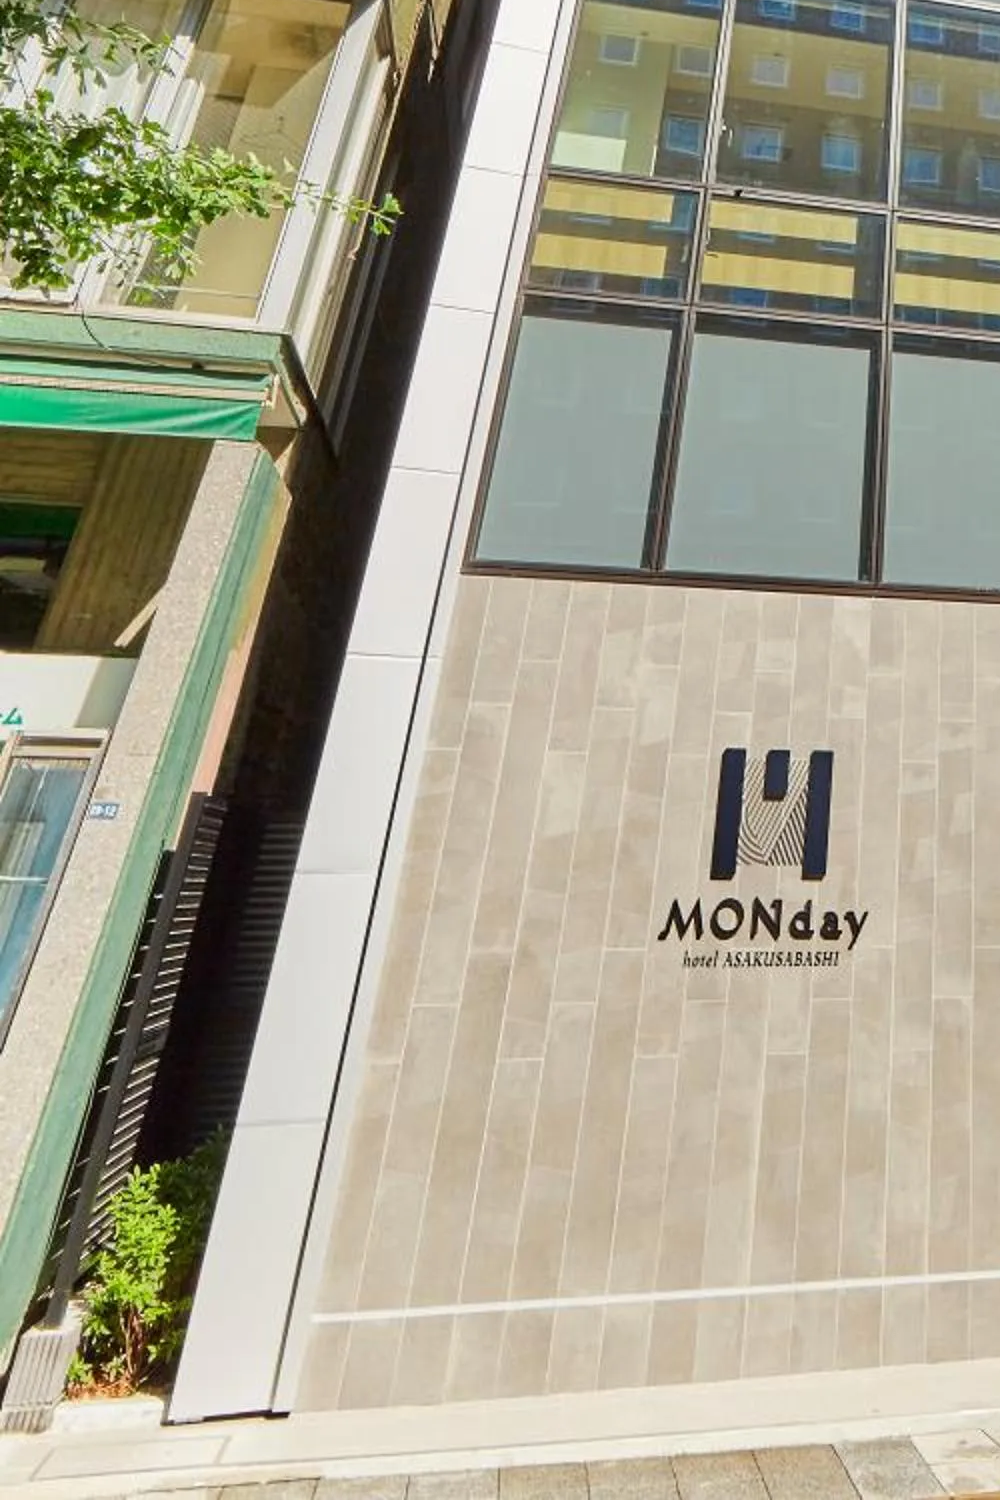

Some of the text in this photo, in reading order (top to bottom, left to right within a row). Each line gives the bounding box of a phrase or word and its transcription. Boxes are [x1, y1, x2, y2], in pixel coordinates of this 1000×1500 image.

[0, 707, 23, 724] ム
[657, 896, 868, 951] MONday
[682, 950, 840, 968] hotel ASAKUSABASHI
